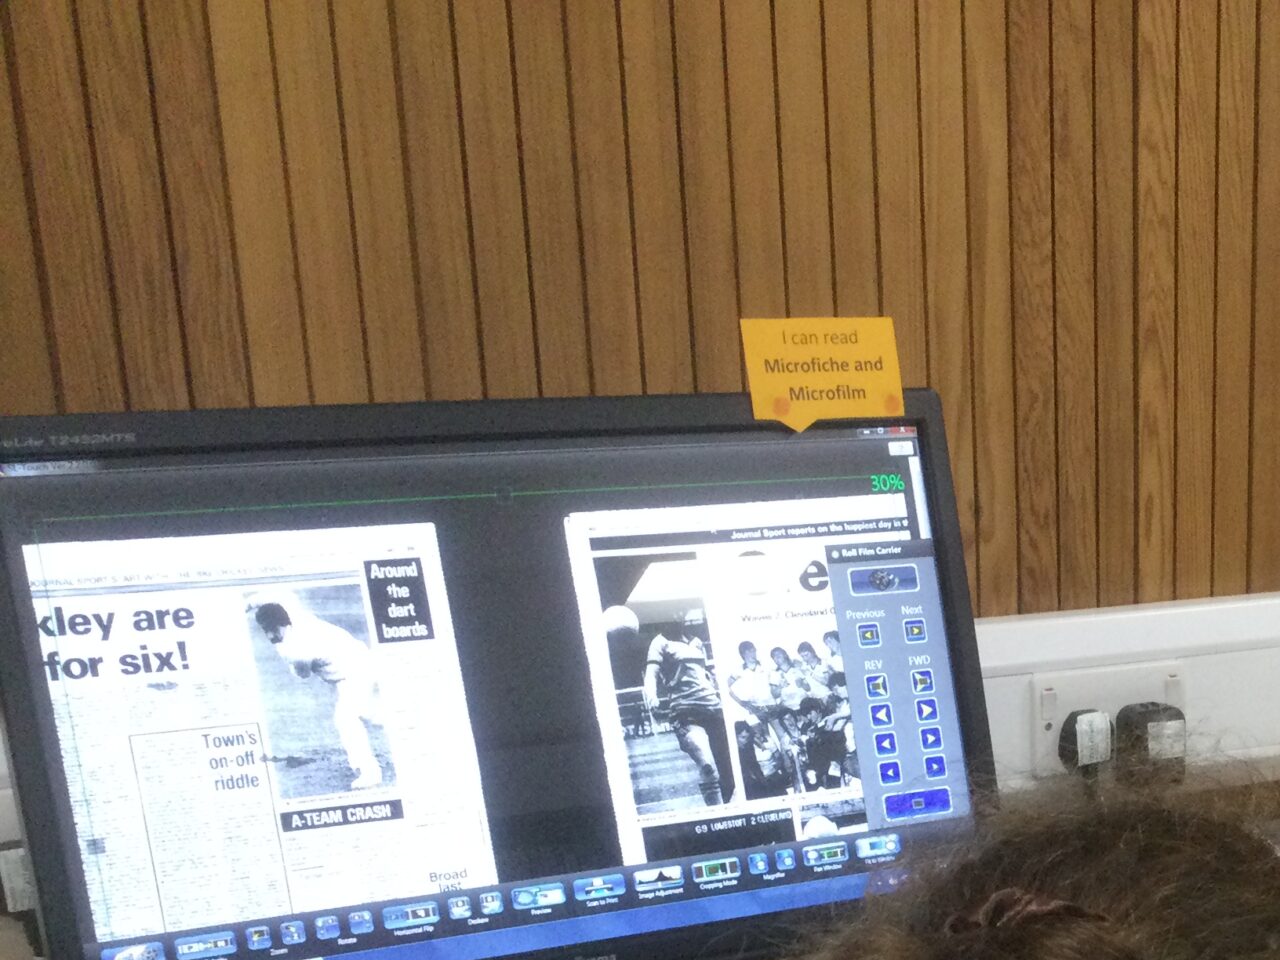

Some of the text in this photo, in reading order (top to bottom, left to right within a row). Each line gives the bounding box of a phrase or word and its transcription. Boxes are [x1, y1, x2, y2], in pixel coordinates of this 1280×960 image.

[782, 330, 858, 345] I can read
[764, 356, 884, 374] Microfiche and
[789, 385, 866, 402] Microfilm
[870, 474, 905, 492] 30%
[731, 530, 762, 540] Journal
[762, 528, 786, 538] Sport
[787, 525, 816, 536] reports
[817, 525, 829, 533] on
[829, 523, 843, 532] the
[844, 520, 877, 531] happiest
[878, 520, 892, 530] day
[842, 546, 902, 558] Roll Film Carrier
[370, 561, 418, 579] Around
[386, 583, 410, 598] the
[387, 602, 416, 618] dart
[846, 609, 886, 620] Previous
[901, 606, 923, 616] Next
[132, 607, 195, 632] are
[382, 620, 429, 638] boards
[43, 641, 190, 681] for six!
[864, 660, 883, 670] REV
[908, 655, 931, 666] FWD
[201, 730, 257, 749] Town's
[209, 750, 256, 770] on-off
[214, 774, 260, 791] riddle
[291, 804, 392, 829] A-TEAM CRASH
[429, 868, 468, 883] Broad
